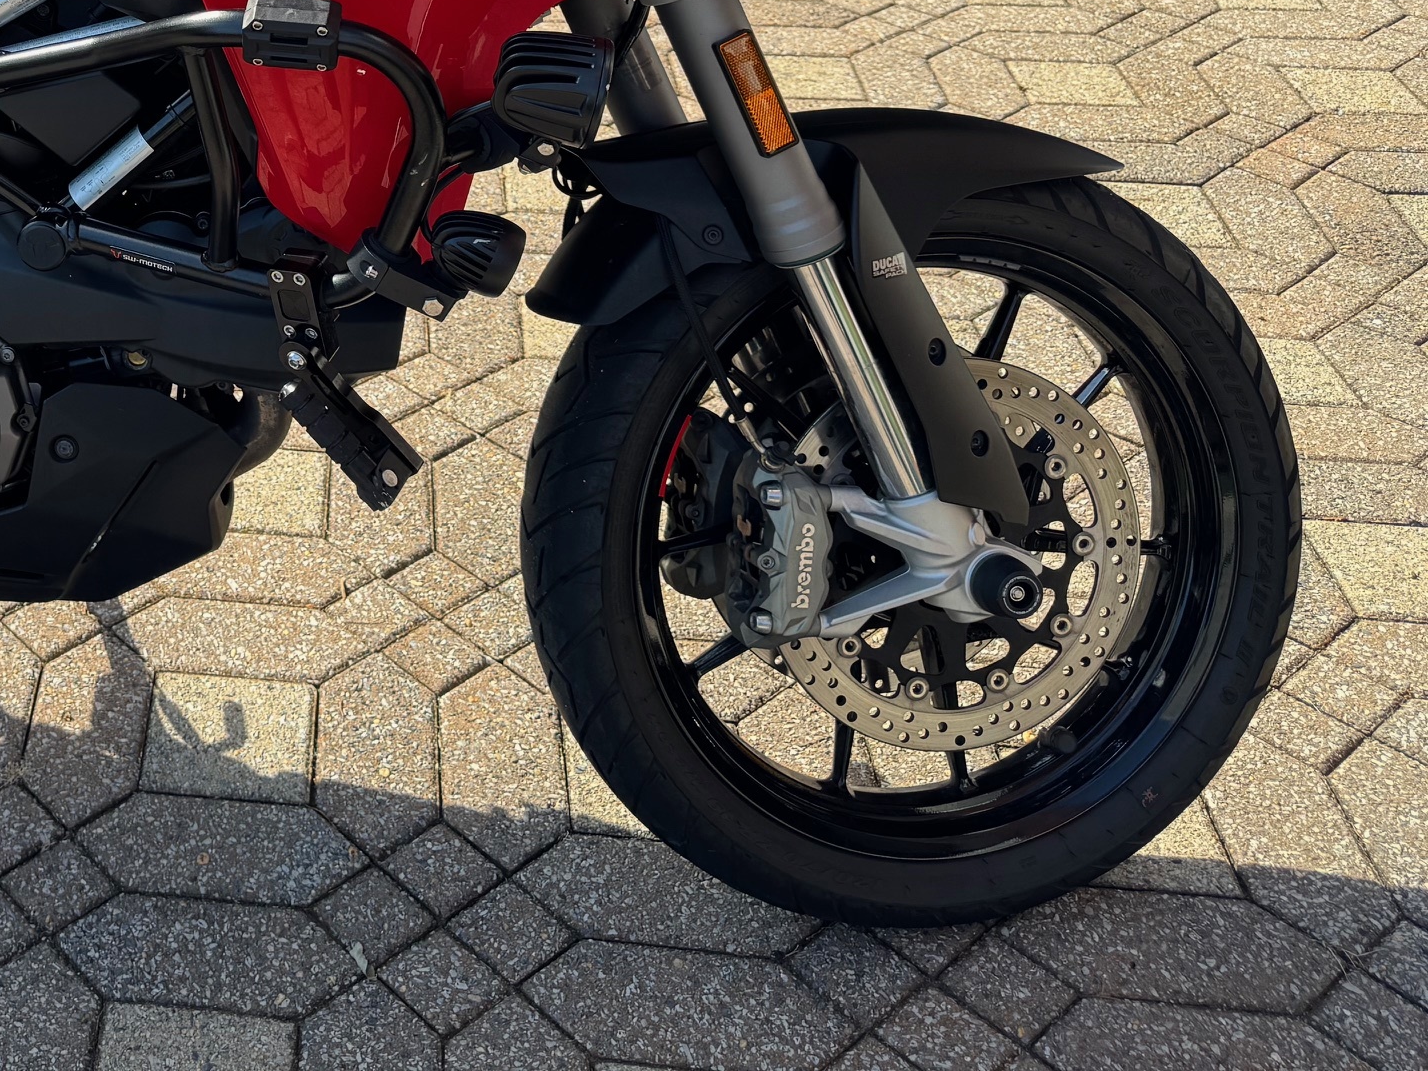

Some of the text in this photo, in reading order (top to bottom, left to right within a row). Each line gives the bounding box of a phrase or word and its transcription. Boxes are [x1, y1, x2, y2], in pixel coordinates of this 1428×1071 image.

[123, 254, 173, 272] SW-MOTECH
[1150, 285, 1271, 484] SCORPION
[1247, 496, 1276, 627] TRAIL
[791, 523, 816, 609] brembo
